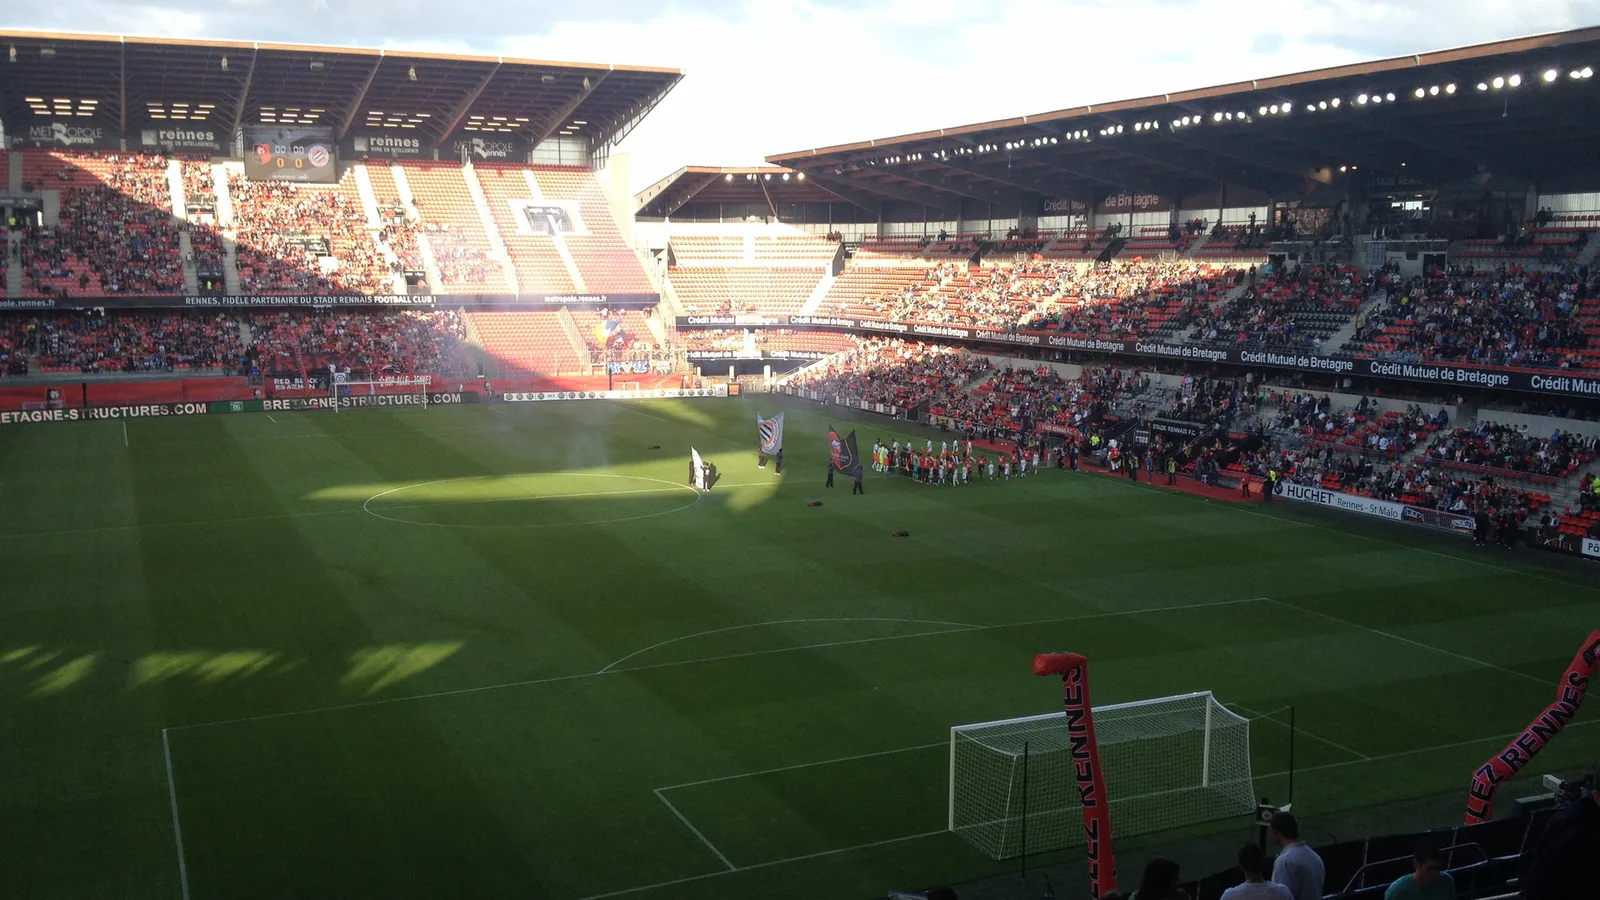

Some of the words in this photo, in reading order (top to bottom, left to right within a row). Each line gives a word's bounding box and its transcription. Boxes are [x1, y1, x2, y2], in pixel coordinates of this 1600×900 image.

[160, 128, 214, 140] rennes
[370, 135, 420, 148] rennes
[186, 297, 220, 306] RENNES,
[223, 296, 249, 304] FIDÈLE
[250, 296, 298, 304] PARTENAIRE
[300, 296, 311, 304] DU
[314, 296, 337, 304] STADE
[340, 296, 372, 304] RENNAIS
[374, 296, 412, 304] FOOTBALL
[413, 296, 432, 304] CLUB
[544, 295, 607, 304] metropole.rennes.fr
[914, 324, 927, 332] Crédit
[942, 327, 947, 335] de
[976, 330, 990, 338] Crédit
[991, 332, 1008, 340] Mutuel
[1008, 332, 1015, 342] de
[1016, 333, 1040, 345] Bretagne
[1048, 336, 1066, 345] Crédit
[1067, 338, 1086, 348] Mutuel
[1087, 339, 1095, 348] de
[1096, 340, 1124, 352] Bretagne
[1136, 342, 1156, 354] Crédit
[1157, 344, 1181, 356] Mutuel
[1182, 346, 1191, 357] de
[1192, 347, 1226, 362] Bretagne
[1241, 351, 1266, 363] Crédit
[1268, 353, 1296, 366] Mutuel
[1298, 356, 1309, 367] de
[1310, 357, 1353, 372] Bretagne
[1370, 361, 1401, 376] Crédit
[1402, 364, 1438, 379] Mutuel
[1440, 368, 1454, 380] de
[1456, 369, 1509, 387] Bretagne
[1531, 376, 1570, 390] Crédit
[263, 394, 462, 411] BRETAGNE-STRUCTURES.COM
[0, 402, 207, 424] ETAGNE-STRUCTURES.COM
[1152, 424, 1166, 432] STADE
[1168, 426, 1188, 435] RENNAIS
[1287, 485, 1334, 504] HUCHET
[1337, 498, 1364, 511] Rennes
[1370, 504, 1377, 514] St
[1378, 506, 1398, 518] Malo
[1498, 670, 1589, 773] RENNES
[1062, 664, 1097, 808] RENNES
